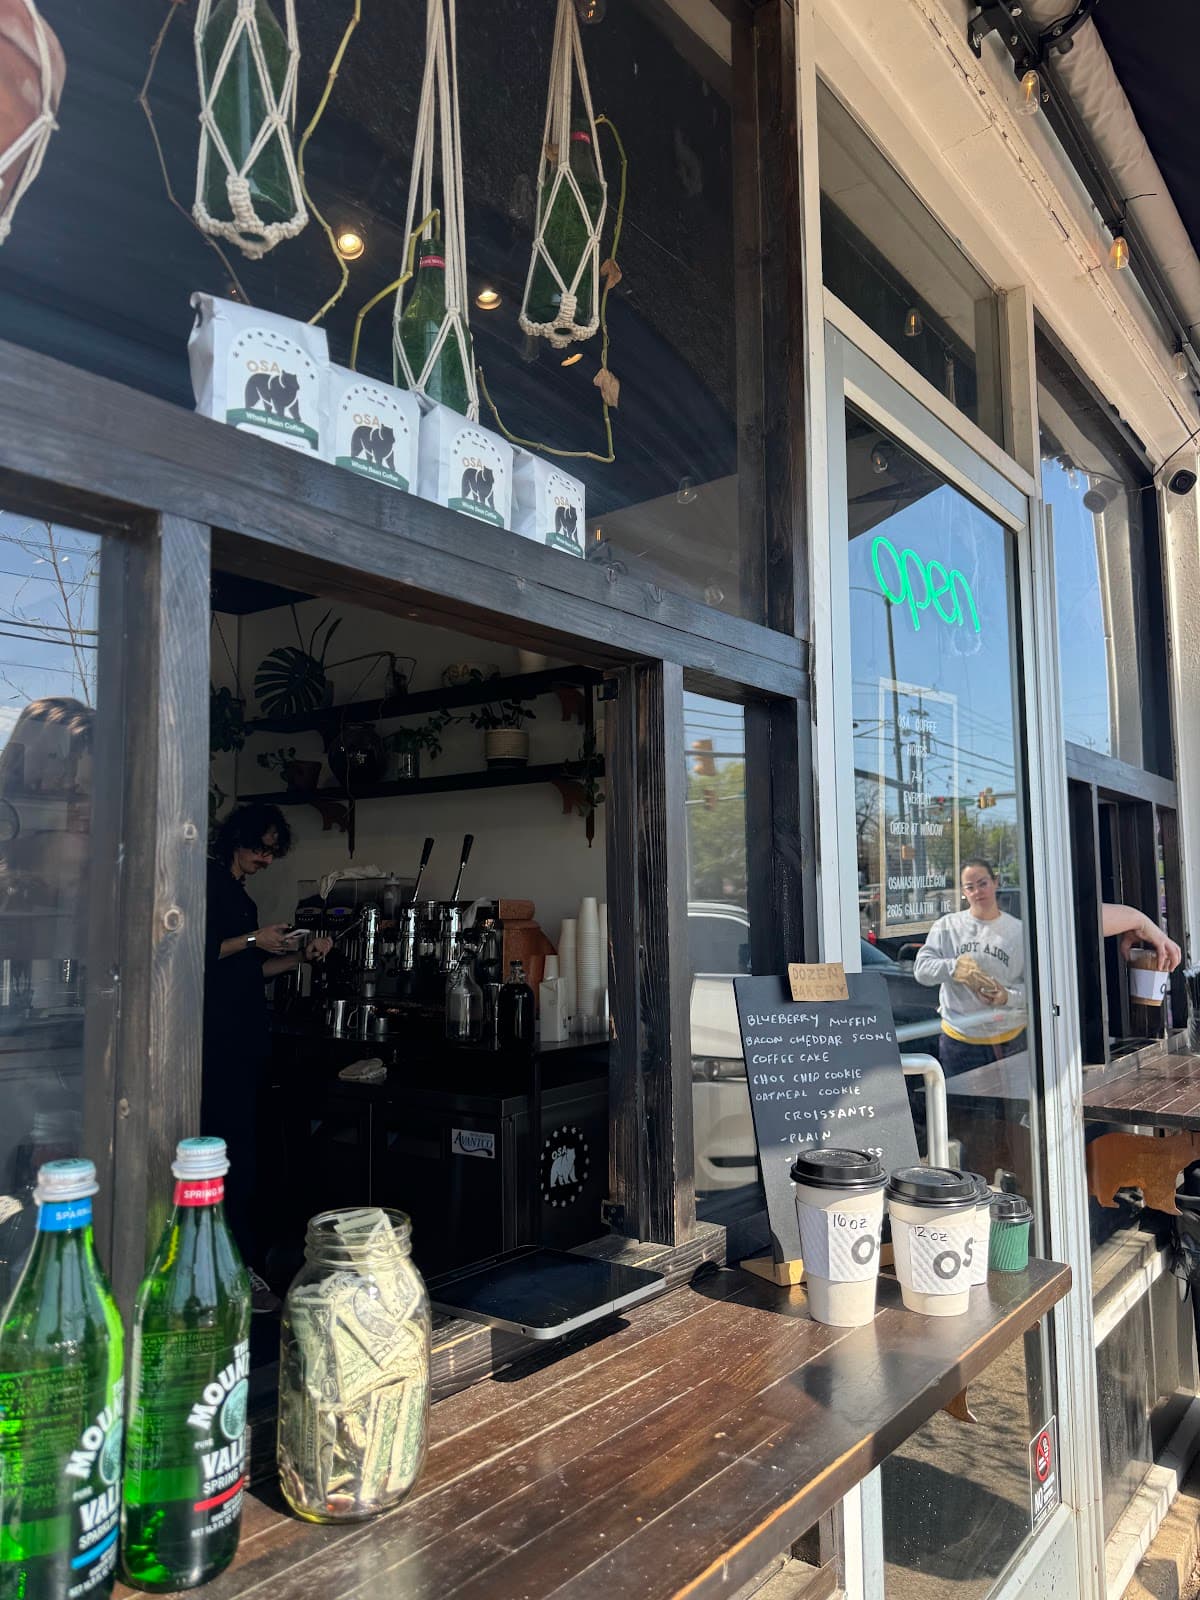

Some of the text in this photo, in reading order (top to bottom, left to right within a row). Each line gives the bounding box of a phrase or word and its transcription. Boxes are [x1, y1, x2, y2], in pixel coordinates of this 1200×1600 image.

[246, 360, 281, 373] OSA
[245, 411, 305, 434] Whole Bean Coffee
[352, 414, 380, 426] OSA
[351, 460, 368, 470] Whole
[462, 457, 484, 469] OSA
[554, 496, 571, 507] OSA
[915, 718, 937, 733] COFFEE
[907, 743, 928, 759] HOURS
[890, 821, 944, 837] ORDER AT WINDOW
[888, 874, 946, 890] OSANASHVILLE.COM
[886, 903, 903, 917] 2605
[904, 901, 934, 916] GALLATIN
[792, 967, 839, 980] DOZEN
[792, 984, 845, 998] BAKERY
[746, 1013, 878, 1028] BLUEBERRY MUFFIN
[745, 1031, 893, 1047] BACON CHEDDAR SCONE
[752, 1051, 831, 1065] COFFEE CAKE
[753, 1068, 863, 1085] CHOC CHIP COOKIE
[755, 1085, 862, 1102] OATMEAL COOKIE
[784, 1105, 876, 1121] CROISSANTS
[551, 1145, 567, 1161] OSA
[832, 1213, 847, 1228] 16
[914, 1226, 927, 1239] 12
[202, 1467, 240, 1496] SPRING
[1034, 1486, 1044, 1515] NO
